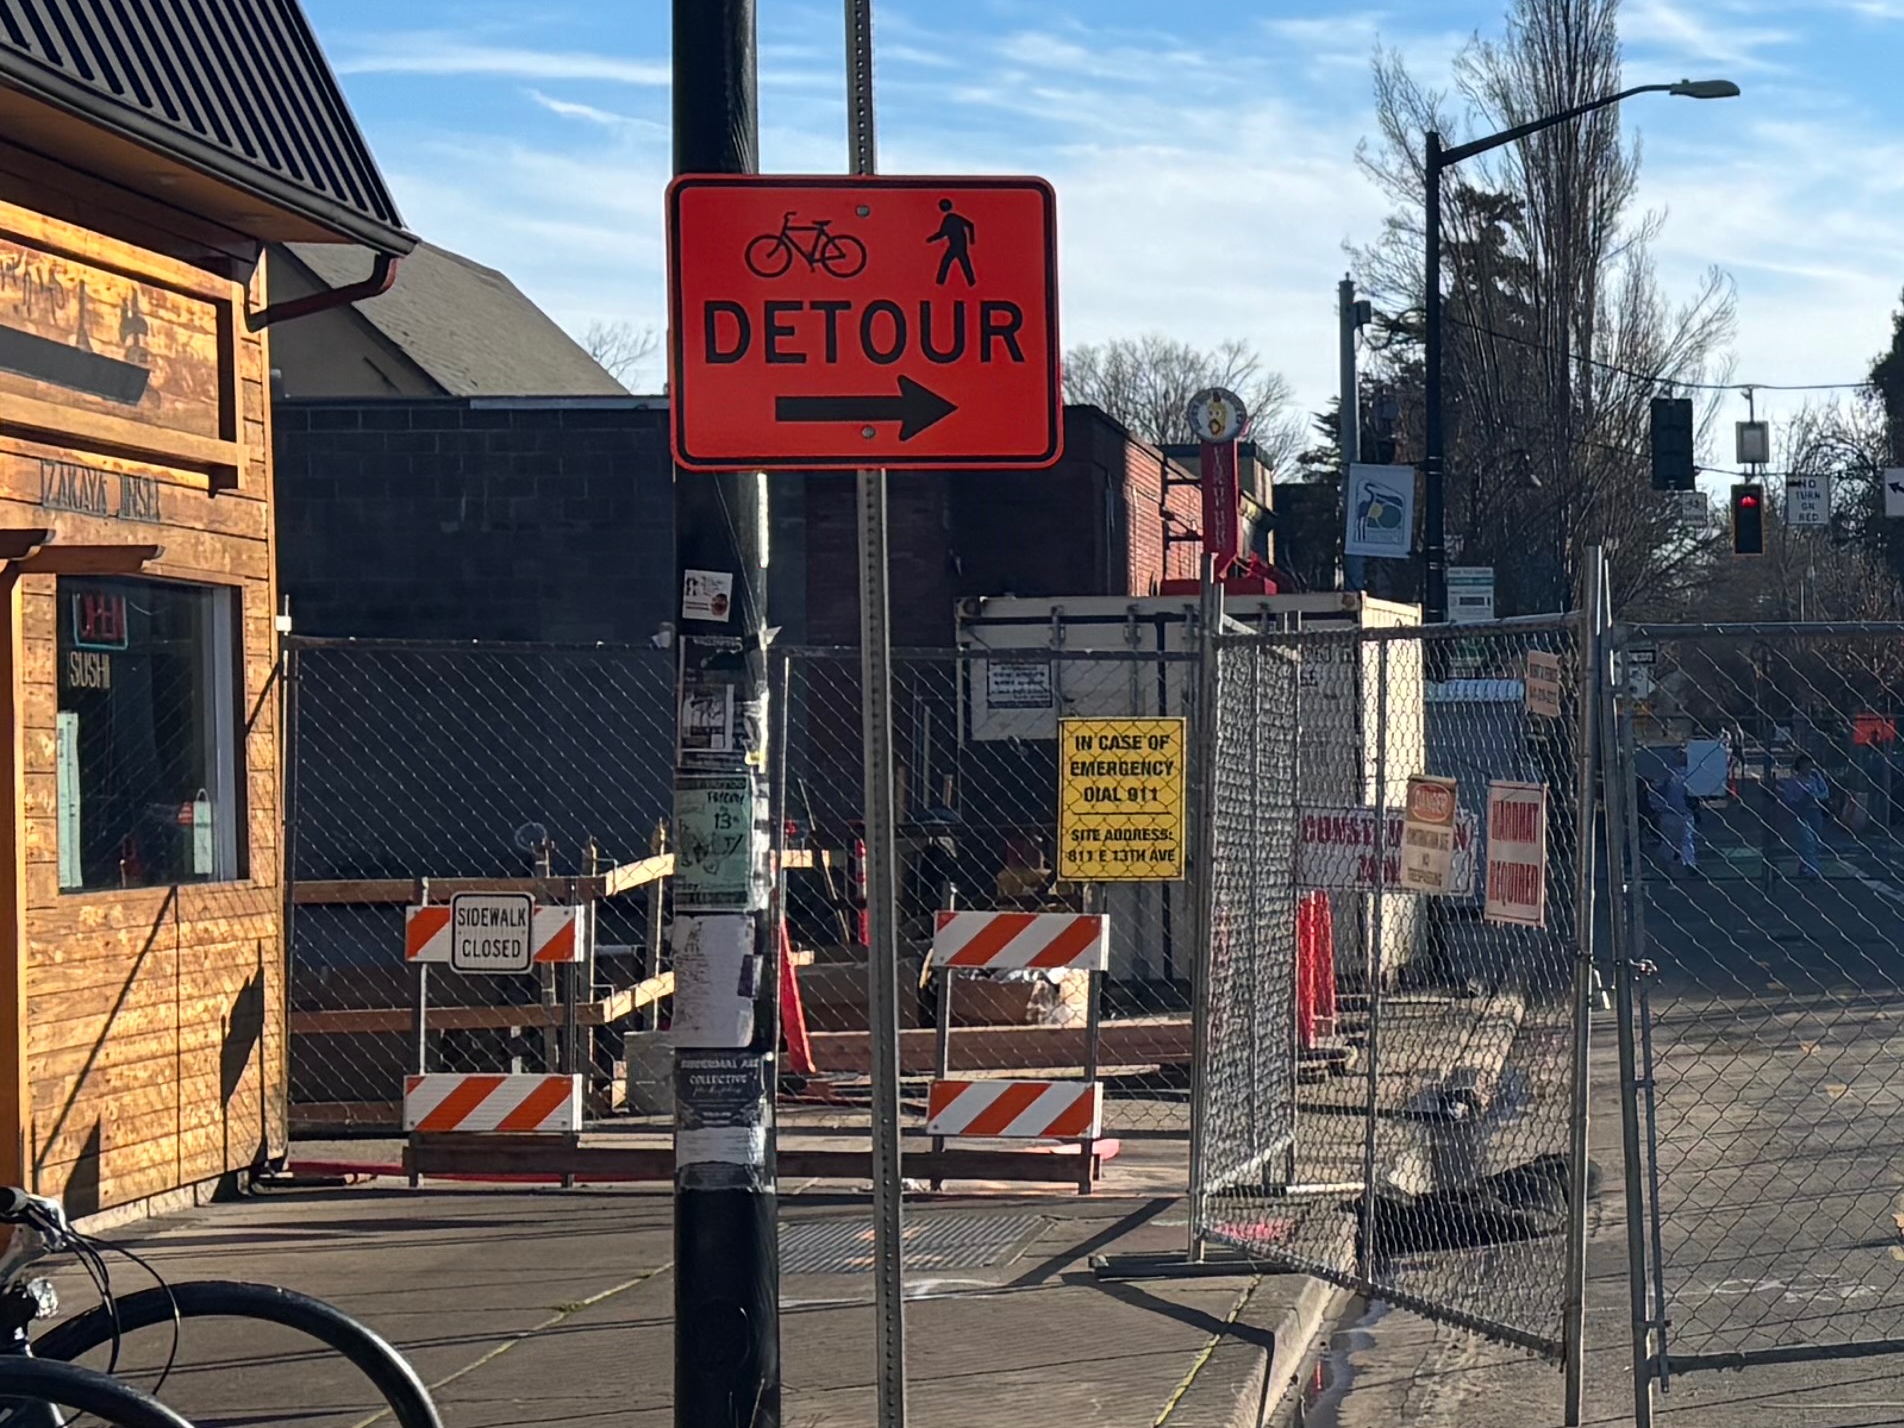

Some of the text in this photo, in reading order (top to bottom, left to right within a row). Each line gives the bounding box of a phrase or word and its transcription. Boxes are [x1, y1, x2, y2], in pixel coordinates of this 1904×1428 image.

[703, 299, 1025, 364] DETOUR
[69, 651, 111, 690] SUSHI
[1075, 735, 1171, 751] IN CASE OF
[1070, 760, 1175, 777] EMERGENCY
[1083, 786, 1158, 802] DIAL 911
[1071, 828, 1174, 842] SITE ADDRESS:
[1099, 850, 1107, 862] E
[1112, 849, 1147, 862] 13TH
[1150, 849, 1176, 862] AVE
[457, 907, 526, 927] SIDEWALK
[462, 938, 521, 958] CLOSED
